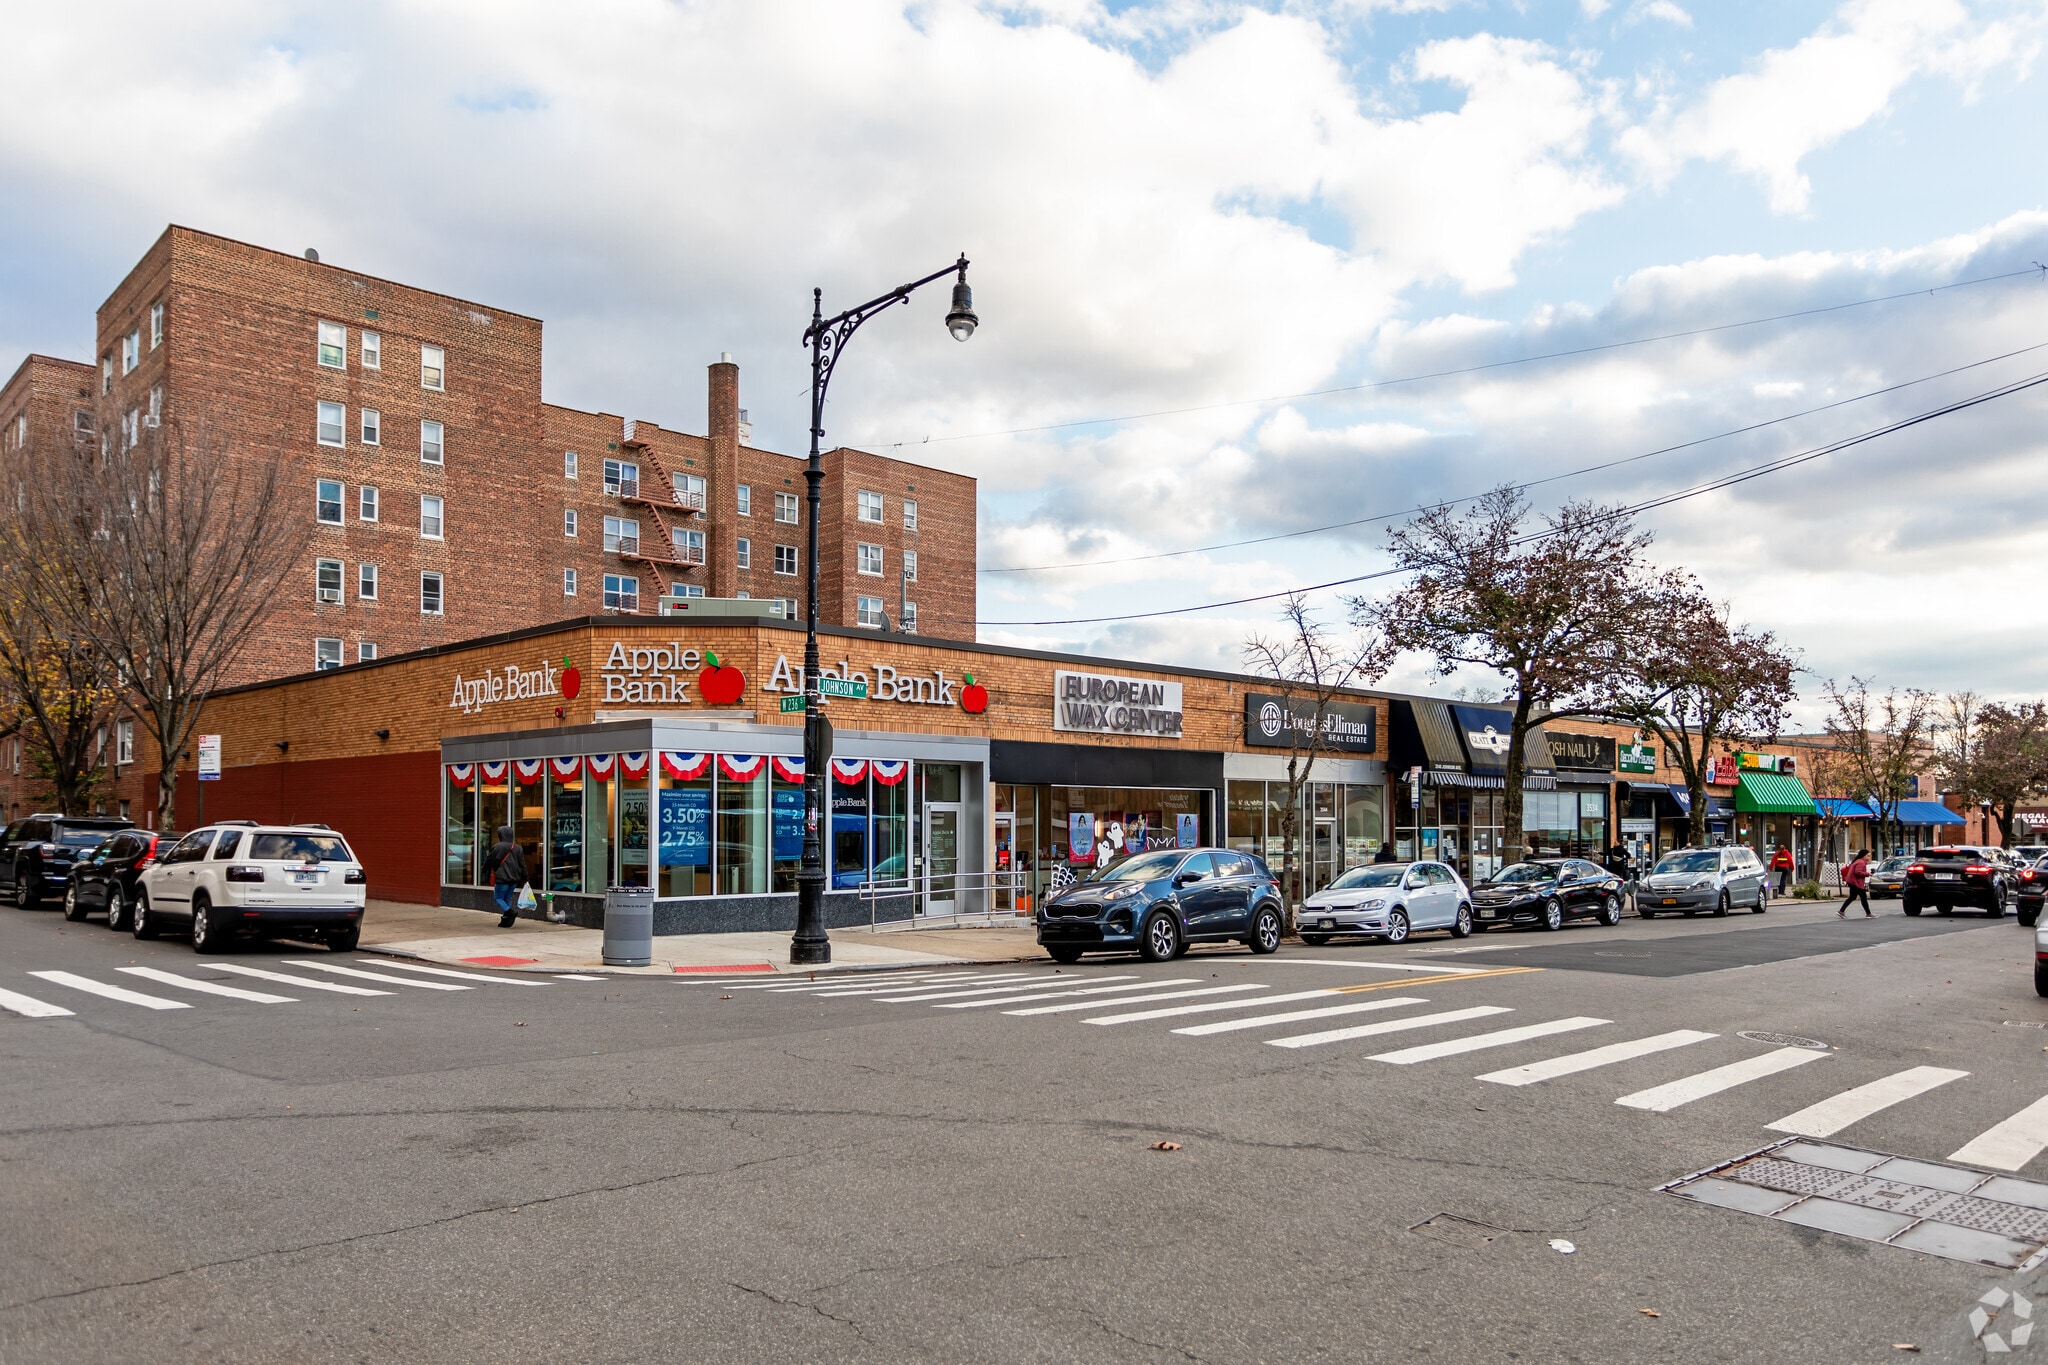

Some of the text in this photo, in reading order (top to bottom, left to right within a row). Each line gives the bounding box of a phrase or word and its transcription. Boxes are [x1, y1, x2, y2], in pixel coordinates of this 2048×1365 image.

[601, 641, 701, 677] Apple
[449, 660, 559, 714] Apple Bank
[601, 674, 692, 703] Bank
[821, 680, 864, 695] JOHNSON AV
[871, 664, 957, 705] Bank
[1061, 675, 1164, 706] EUROPEAN
[782, 699, 787, 710] W
[788, 698, 799, 710] 236
[1061, 702, 1183, 733] WAX CENTER
[1328, 734, 1367, 743] REAL ESTATE
[1548, 741, 1566, 756] OSH
[1567, 742, 1587, 758] NAIL
[832, 797, 867, 808] pple Bank
[662, 808, 705, 823] 3.50%
[792, 809, 805, 820] 2.7
[792, 825, 805, 836] 3.5
[662, 831, 705, 847] 2.75%
